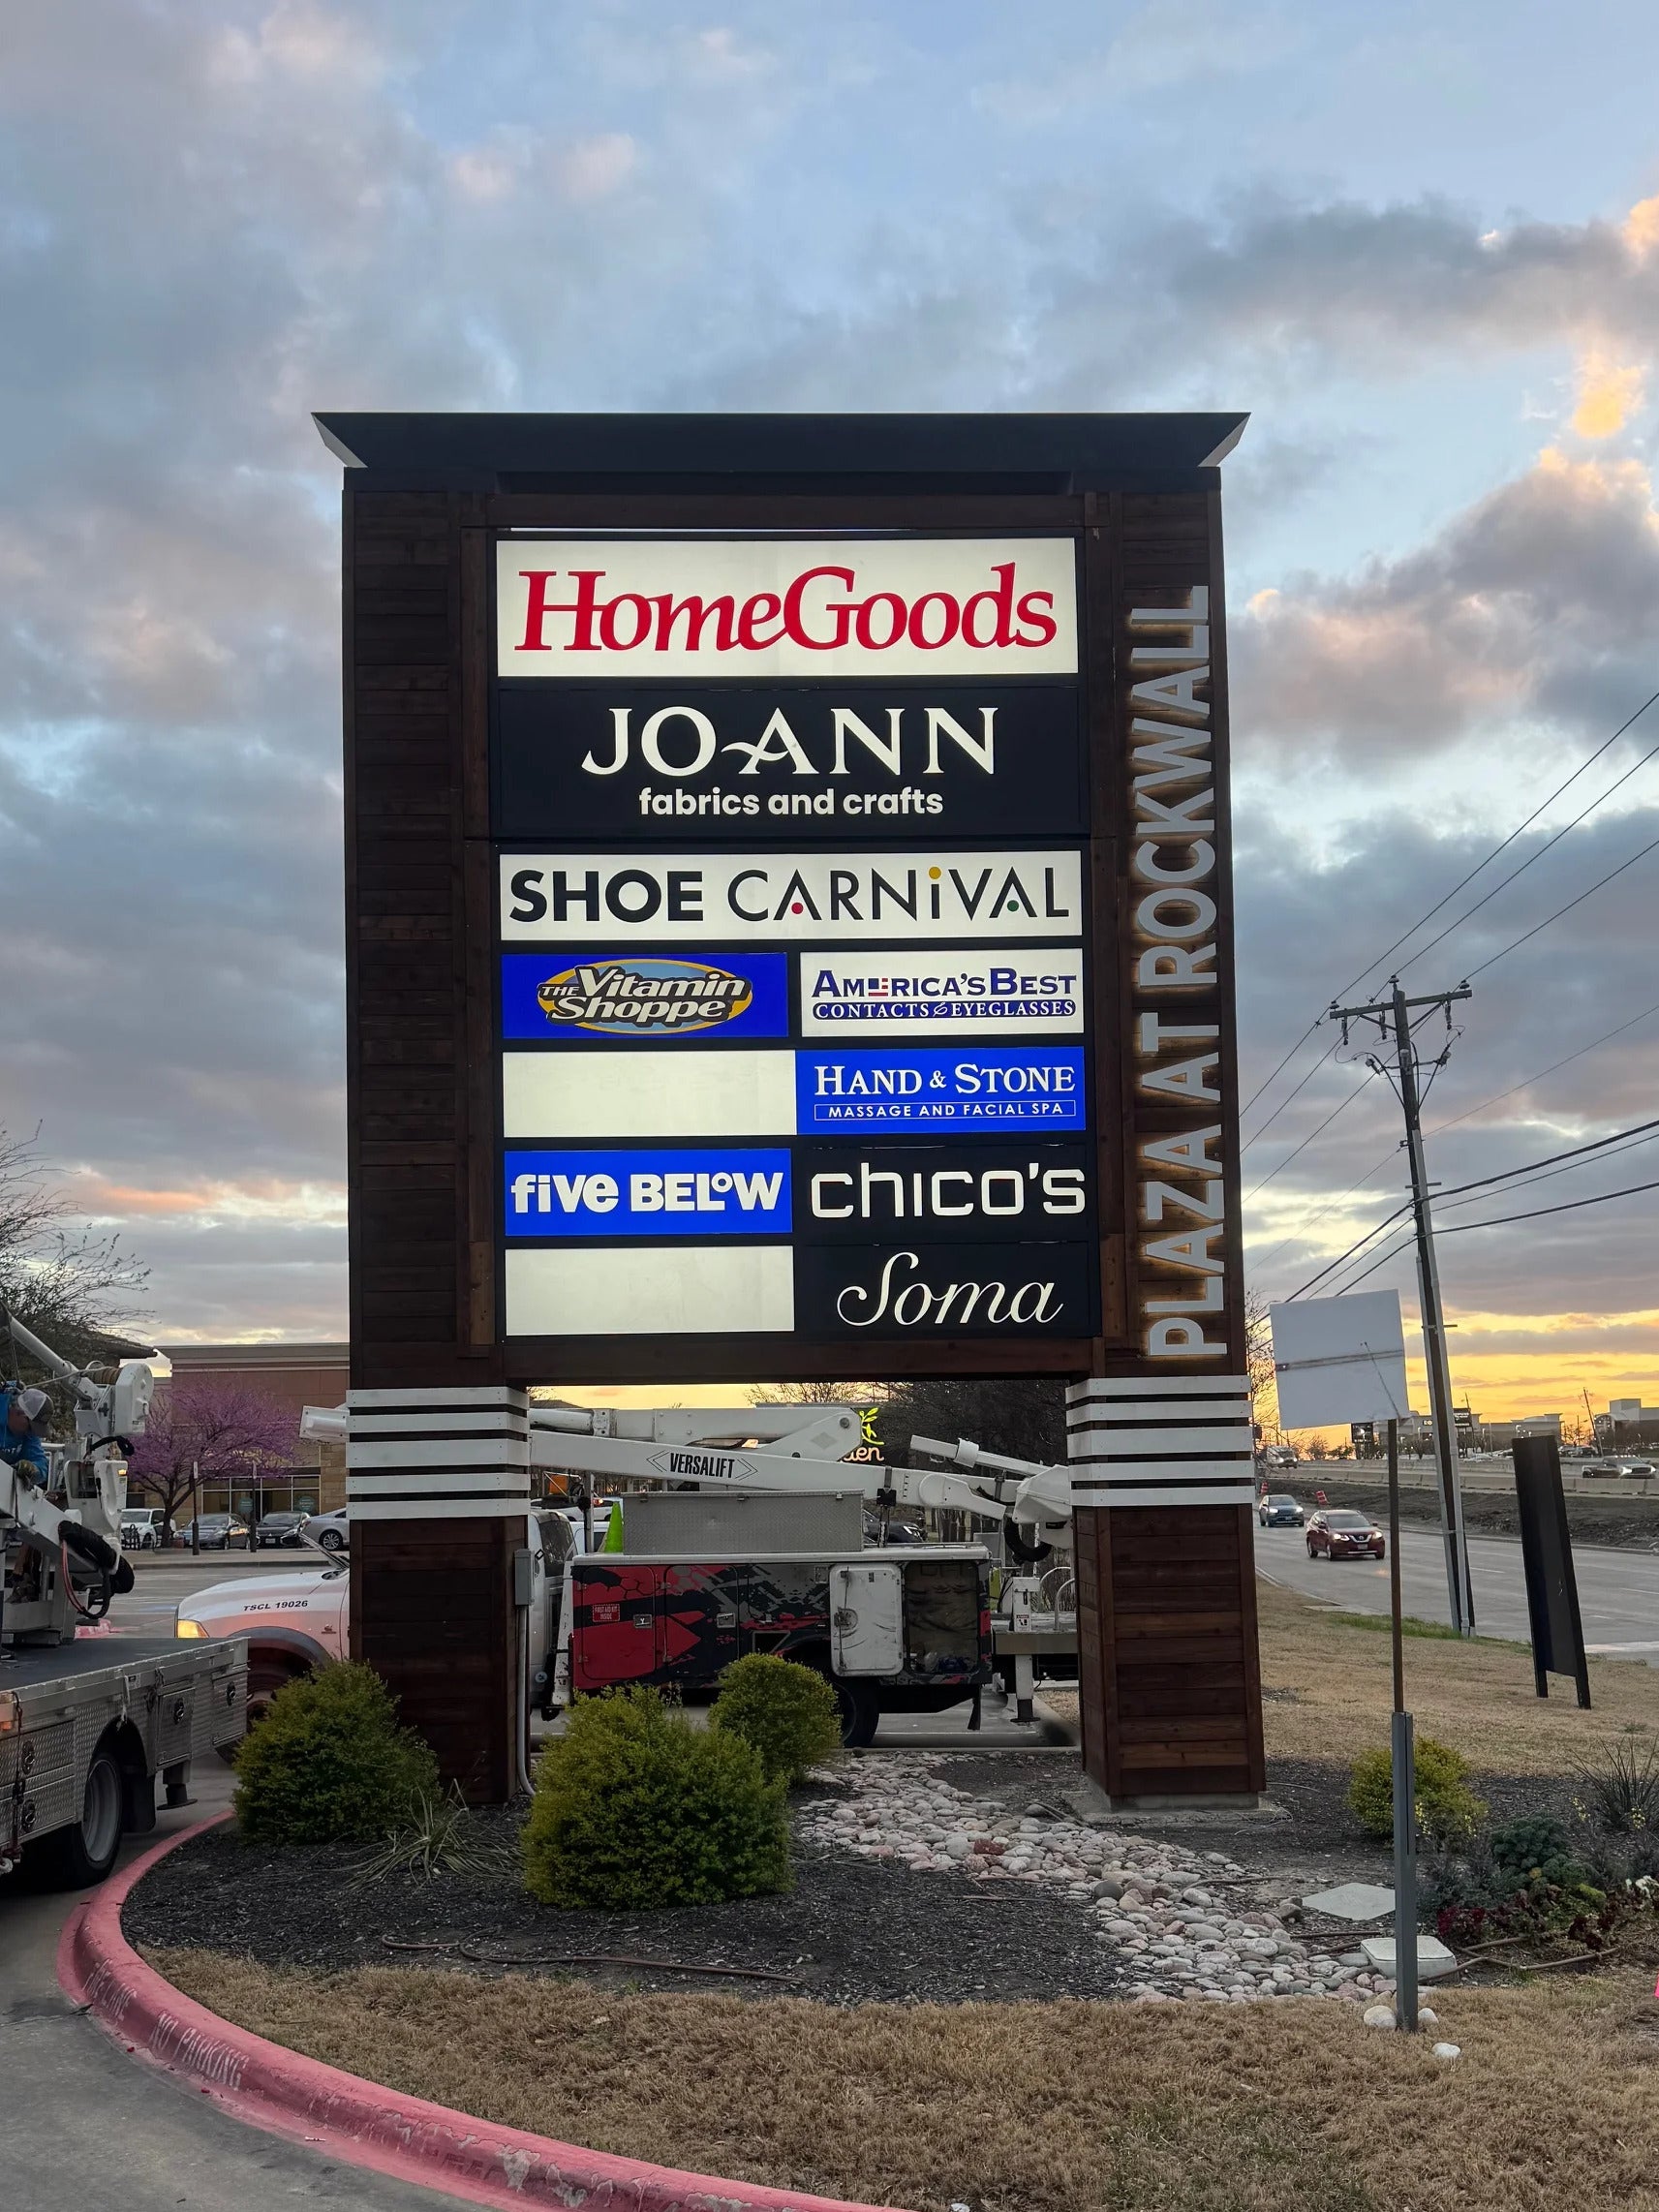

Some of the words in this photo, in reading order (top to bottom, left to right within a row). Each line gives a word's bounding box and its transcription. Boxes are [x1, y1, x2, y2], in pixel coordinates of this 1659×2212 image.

[514, 562, 1058, 652] HomeGoods
[581, 707, 998, 776] JOANN
[639, 786, 760, 816] fabrics
[767, 786, 836, 814] and
[842, 786, 943, 814] crafts
[1129, 585, 1217, 990] ROCKWALL
[510, 870, 704, 923] SHOE
[542, 986, 579, 997] THE
[577, 968, 746, 998] Vitamin
[989, 968, 1077, 996] BEST
[551, 997, 726, 1023] Shoppe
[814, 1001, 930, 1018] CONTACTS
[950, 999, 1075, 1017] EYEGLASSES
[1142, 1011, 1220, 1105] AT
[814, 1065, 922, 1095] HAND
[929, 1070, 947, 1089] &
[955, 1063, 1076, 1094] STONE
[828, 1106, 911, 1118] MASSAGE
[919, 1105, 956, 1117] AND
[963, 1103, 1025, 1116] FACIAL
[1031, 1102, 1063, 1115] SPA
[511, 1173, 619, 1214] five
[811, 1162, 1086, 1218] chico's
[1144, 1123, 1227, 1358] PLAZA
[836, 1251, 1063, 1328] Soma
[670, 1453, 735, 1479] VERSALIFT
[244, 1603, 271, 1612] TSCL
[275, 1600, 308, 1609] 19026
[148, 2012, 179, 2050] NO
[172, 2027, 250, 2091] PARKING
